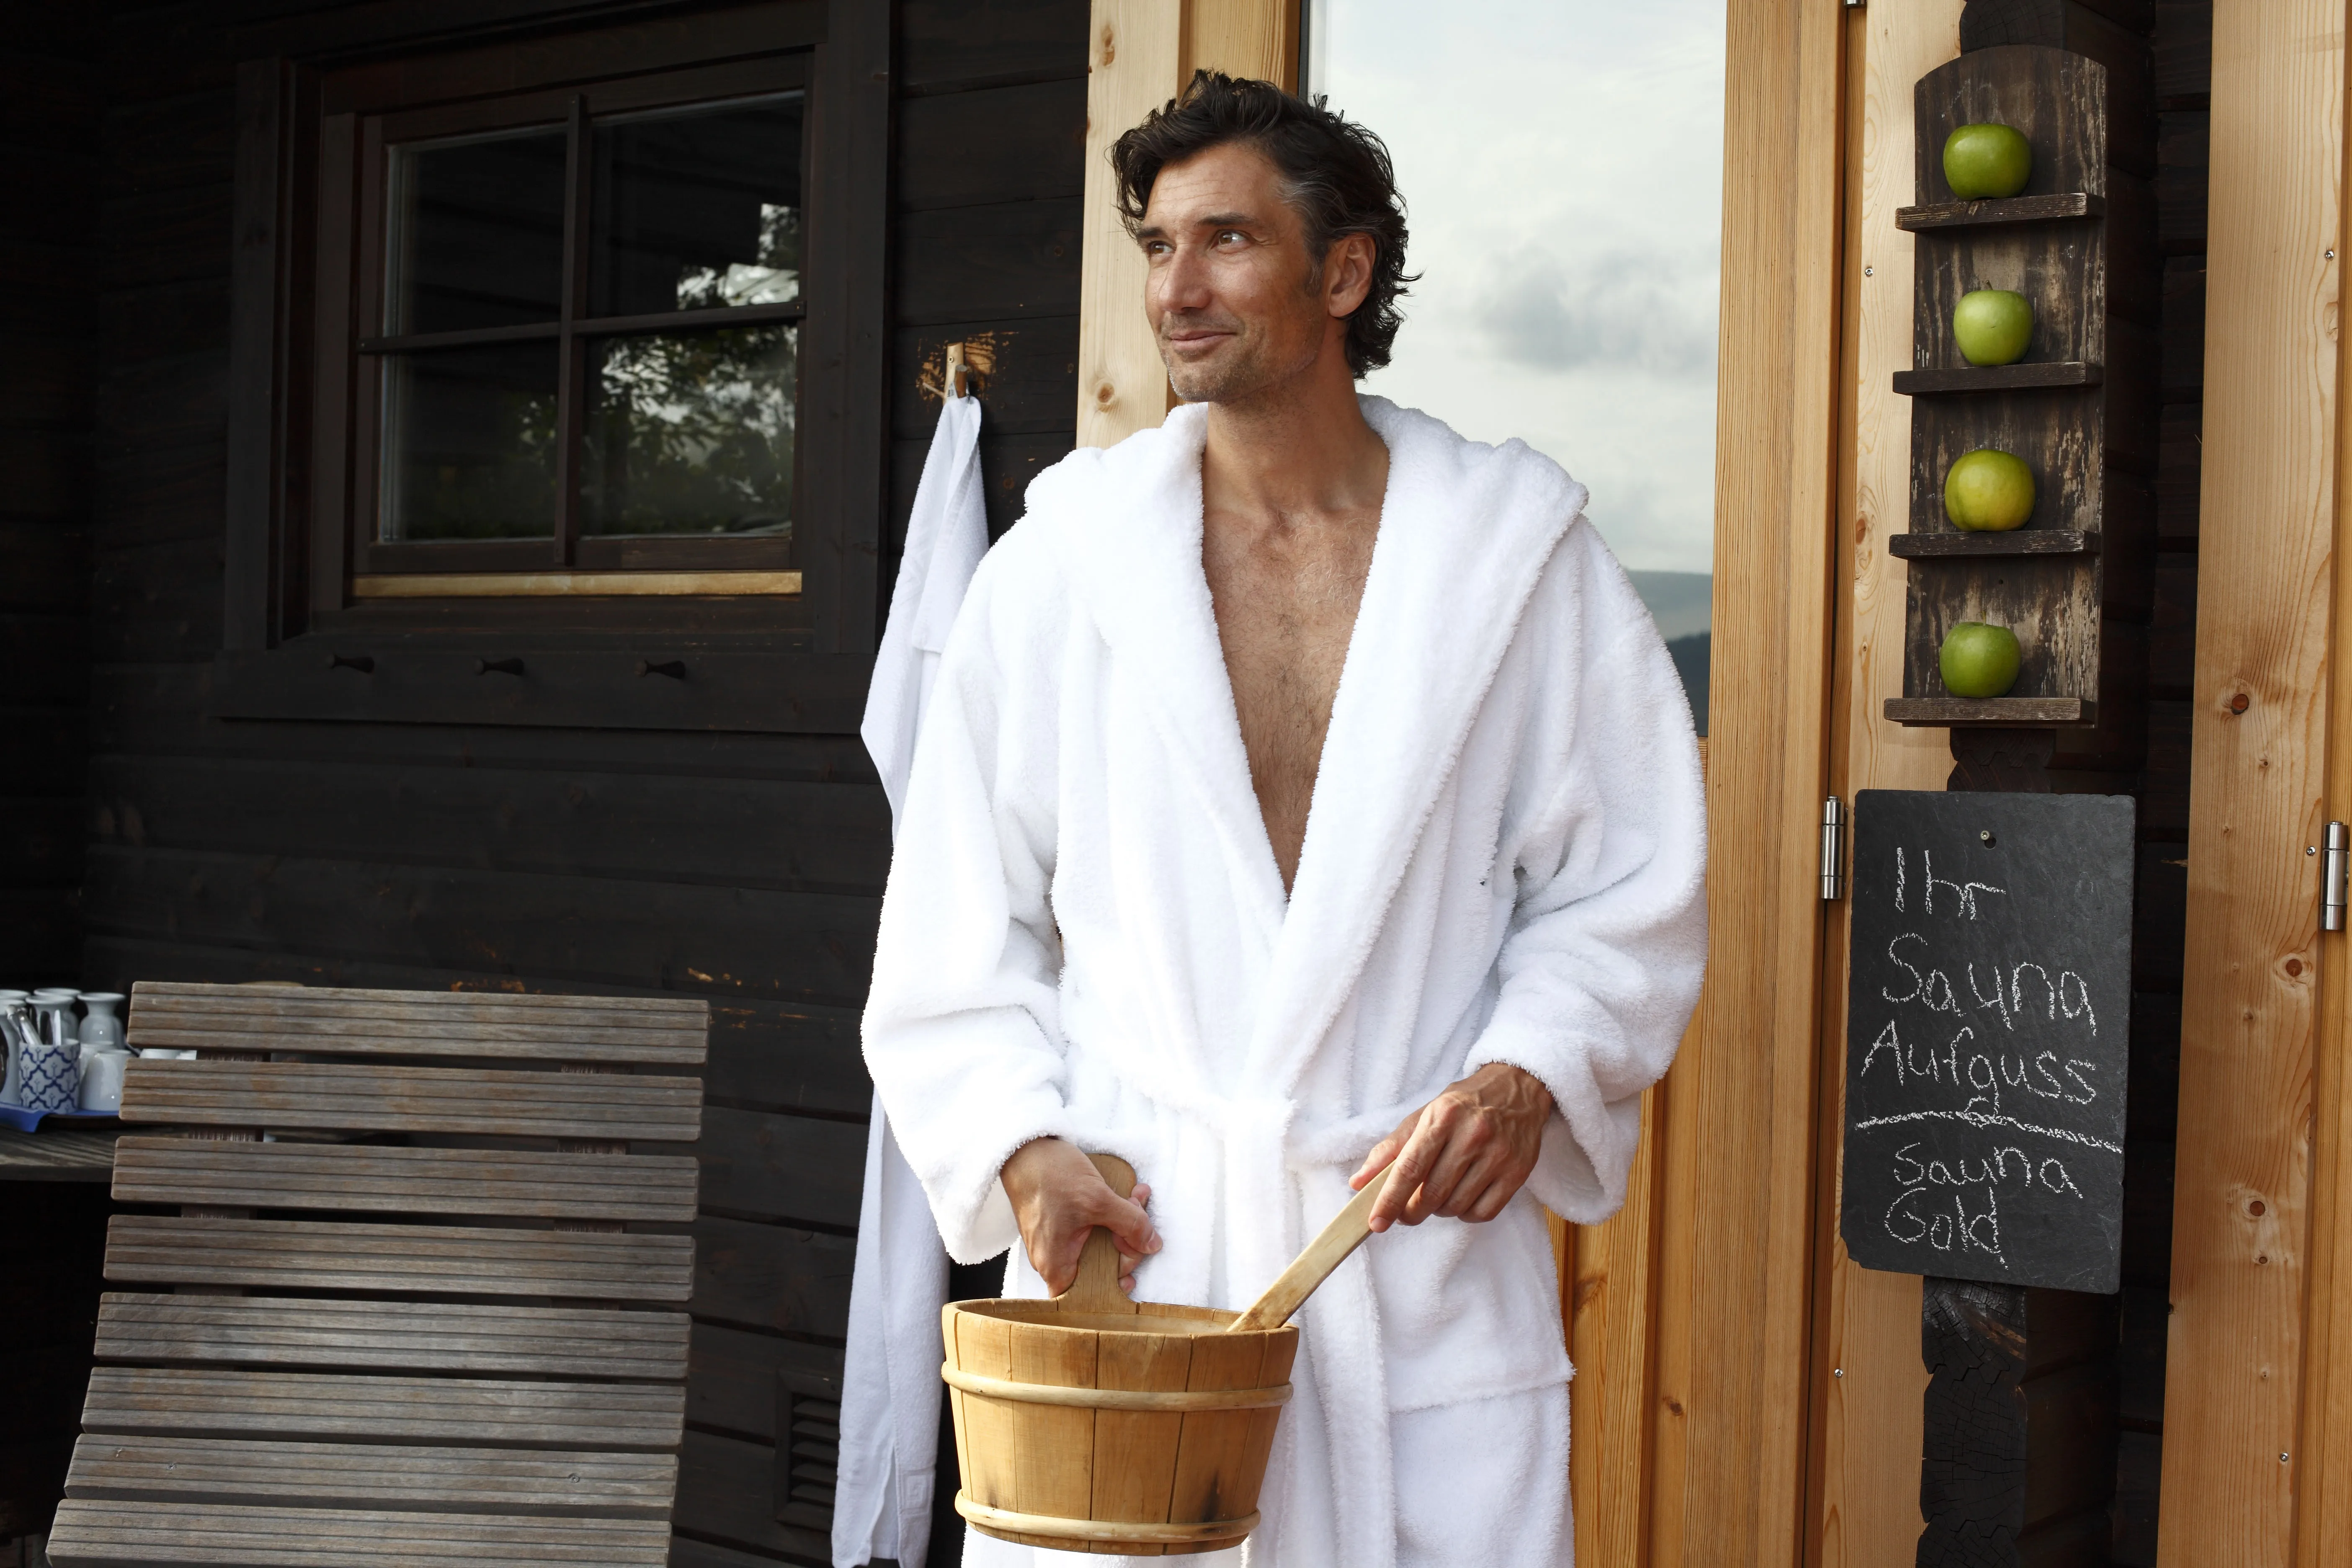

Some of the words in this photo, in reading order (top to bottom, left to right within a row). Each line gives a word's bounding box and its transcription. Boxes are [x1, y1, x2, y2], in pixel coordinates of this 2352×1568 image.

[1882, 932, 2097, 1036] Sauna
[1860, 1019, 2097, 1127] Aufguss
[1894, 1142, 2084, 1199] Sauna
[1884, 1186, 2009, 1271] Gold
